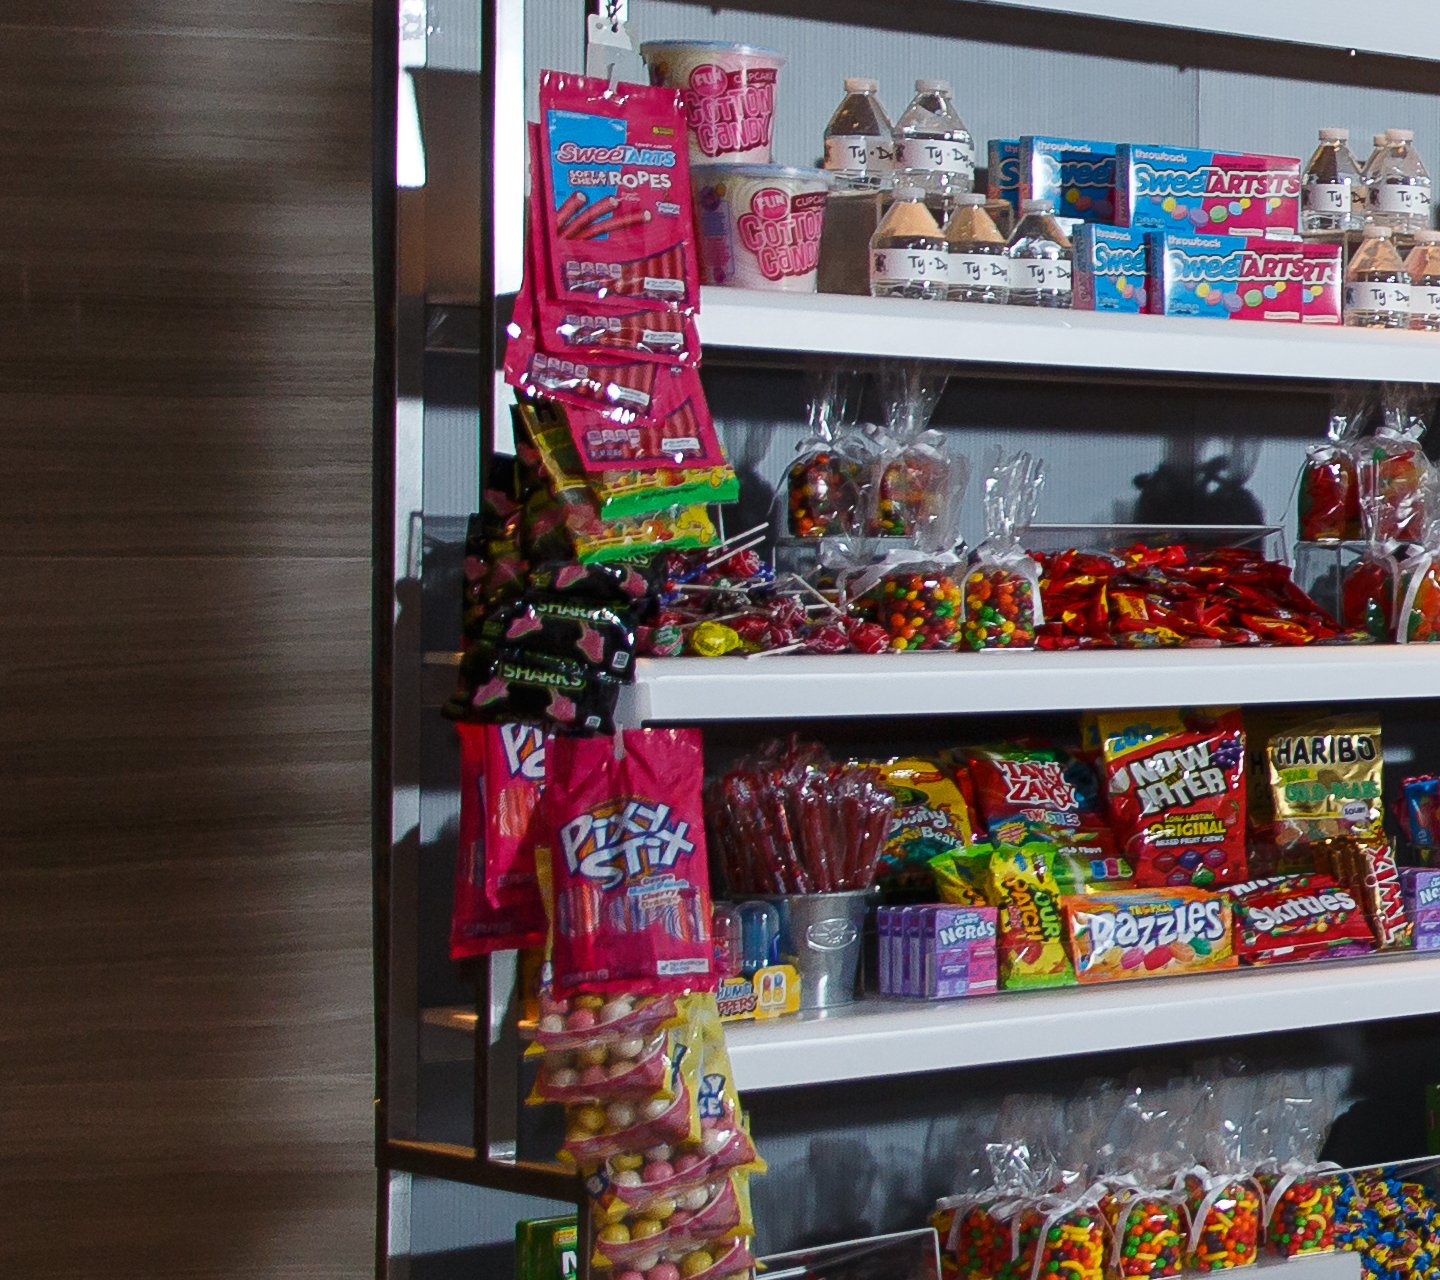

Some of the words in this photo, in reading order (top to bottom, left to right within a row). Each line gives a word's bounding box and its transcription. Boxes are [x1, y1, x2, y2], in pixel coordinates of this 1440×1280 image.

[687, 84, 773, 127] COTTON
[557, 141, 677, 169] SweeTARTS
[1036, 141, 1092, 155] throwback
[1134, 148, 1188, 164] throwback
[608, 170, 672, 189] ROPES
[756, 194, 788, 216] FUN
[1167, 235, 1221, 249] throwback
[1128, 739, 1214, 787] NOW
[1275, 735, 1377, 766] HARIBO
[1136, 766, 1230, 817] LATER
[1150, 820, 1227, 840] ORIGINAL
[1249, 891, 1356, 932] Skittles
